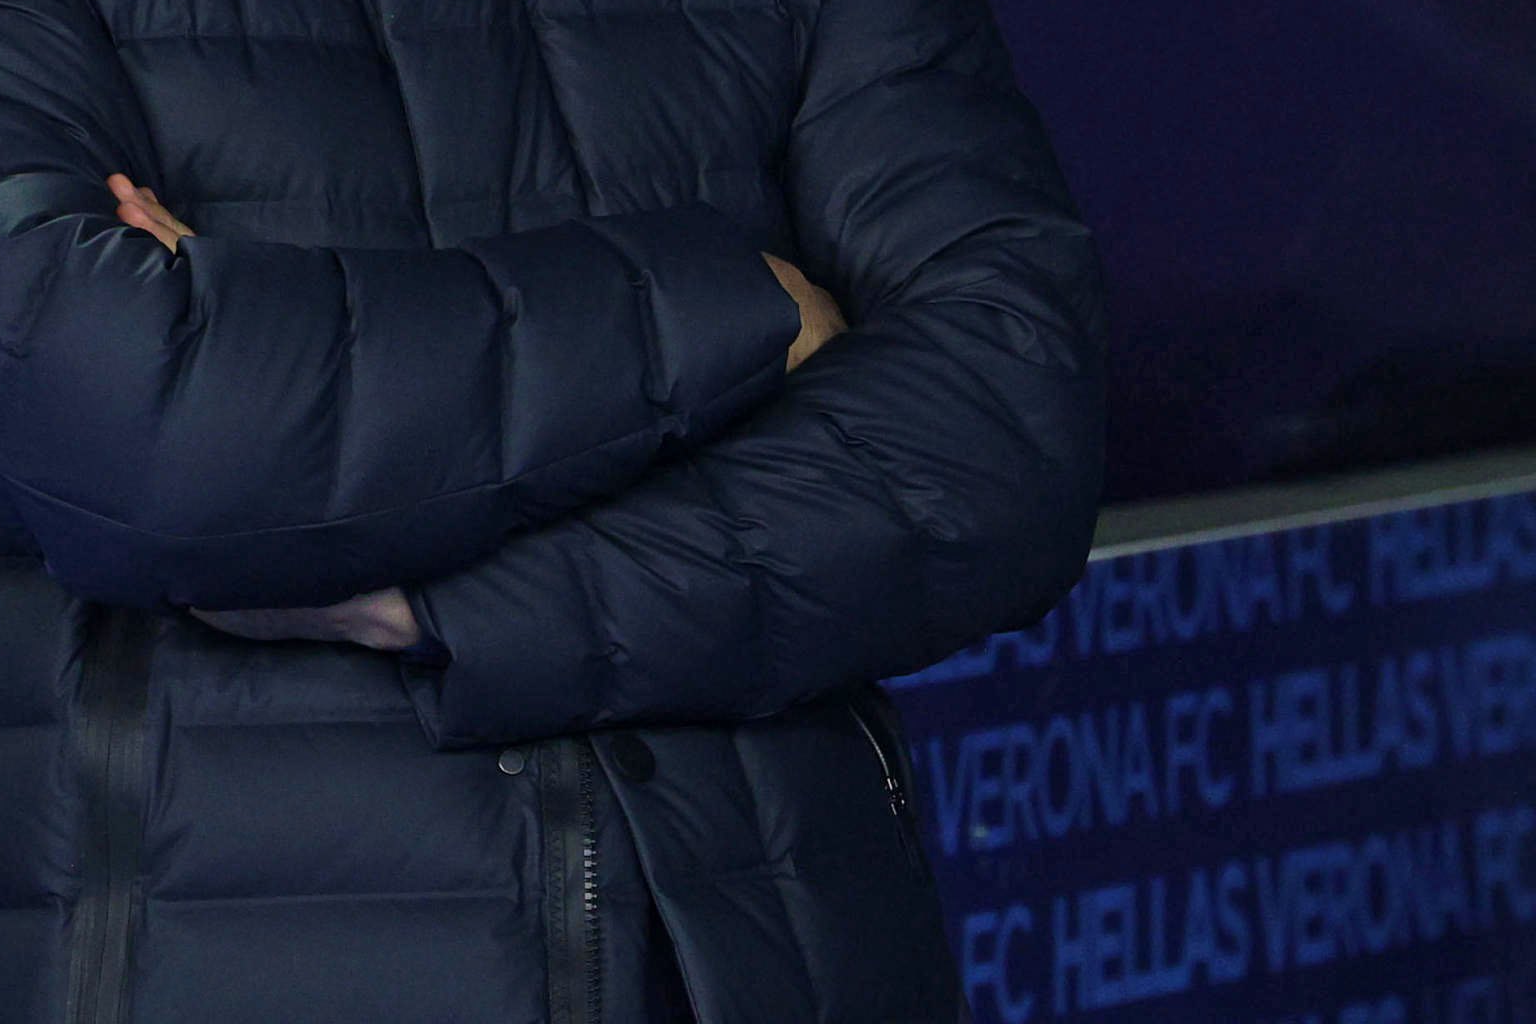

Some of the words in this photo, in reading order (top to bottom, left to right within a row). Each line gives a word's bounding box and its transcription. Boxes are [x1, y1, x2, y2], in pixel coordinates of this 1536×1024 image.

[1069, 534, 1282, 659] VERONA
[1287, 527, 1355, 617] FC
[927, 698, 1159, 857] VERONA
[1166, 687, 1235, 816] FC
[1249, 649, 1440, 797] HELLAS
[963, 902, 1035, 1024] FC
[1051, 857, 1252, 1014] HELLAS
[1254, 818, 1471, 973] VERONA
